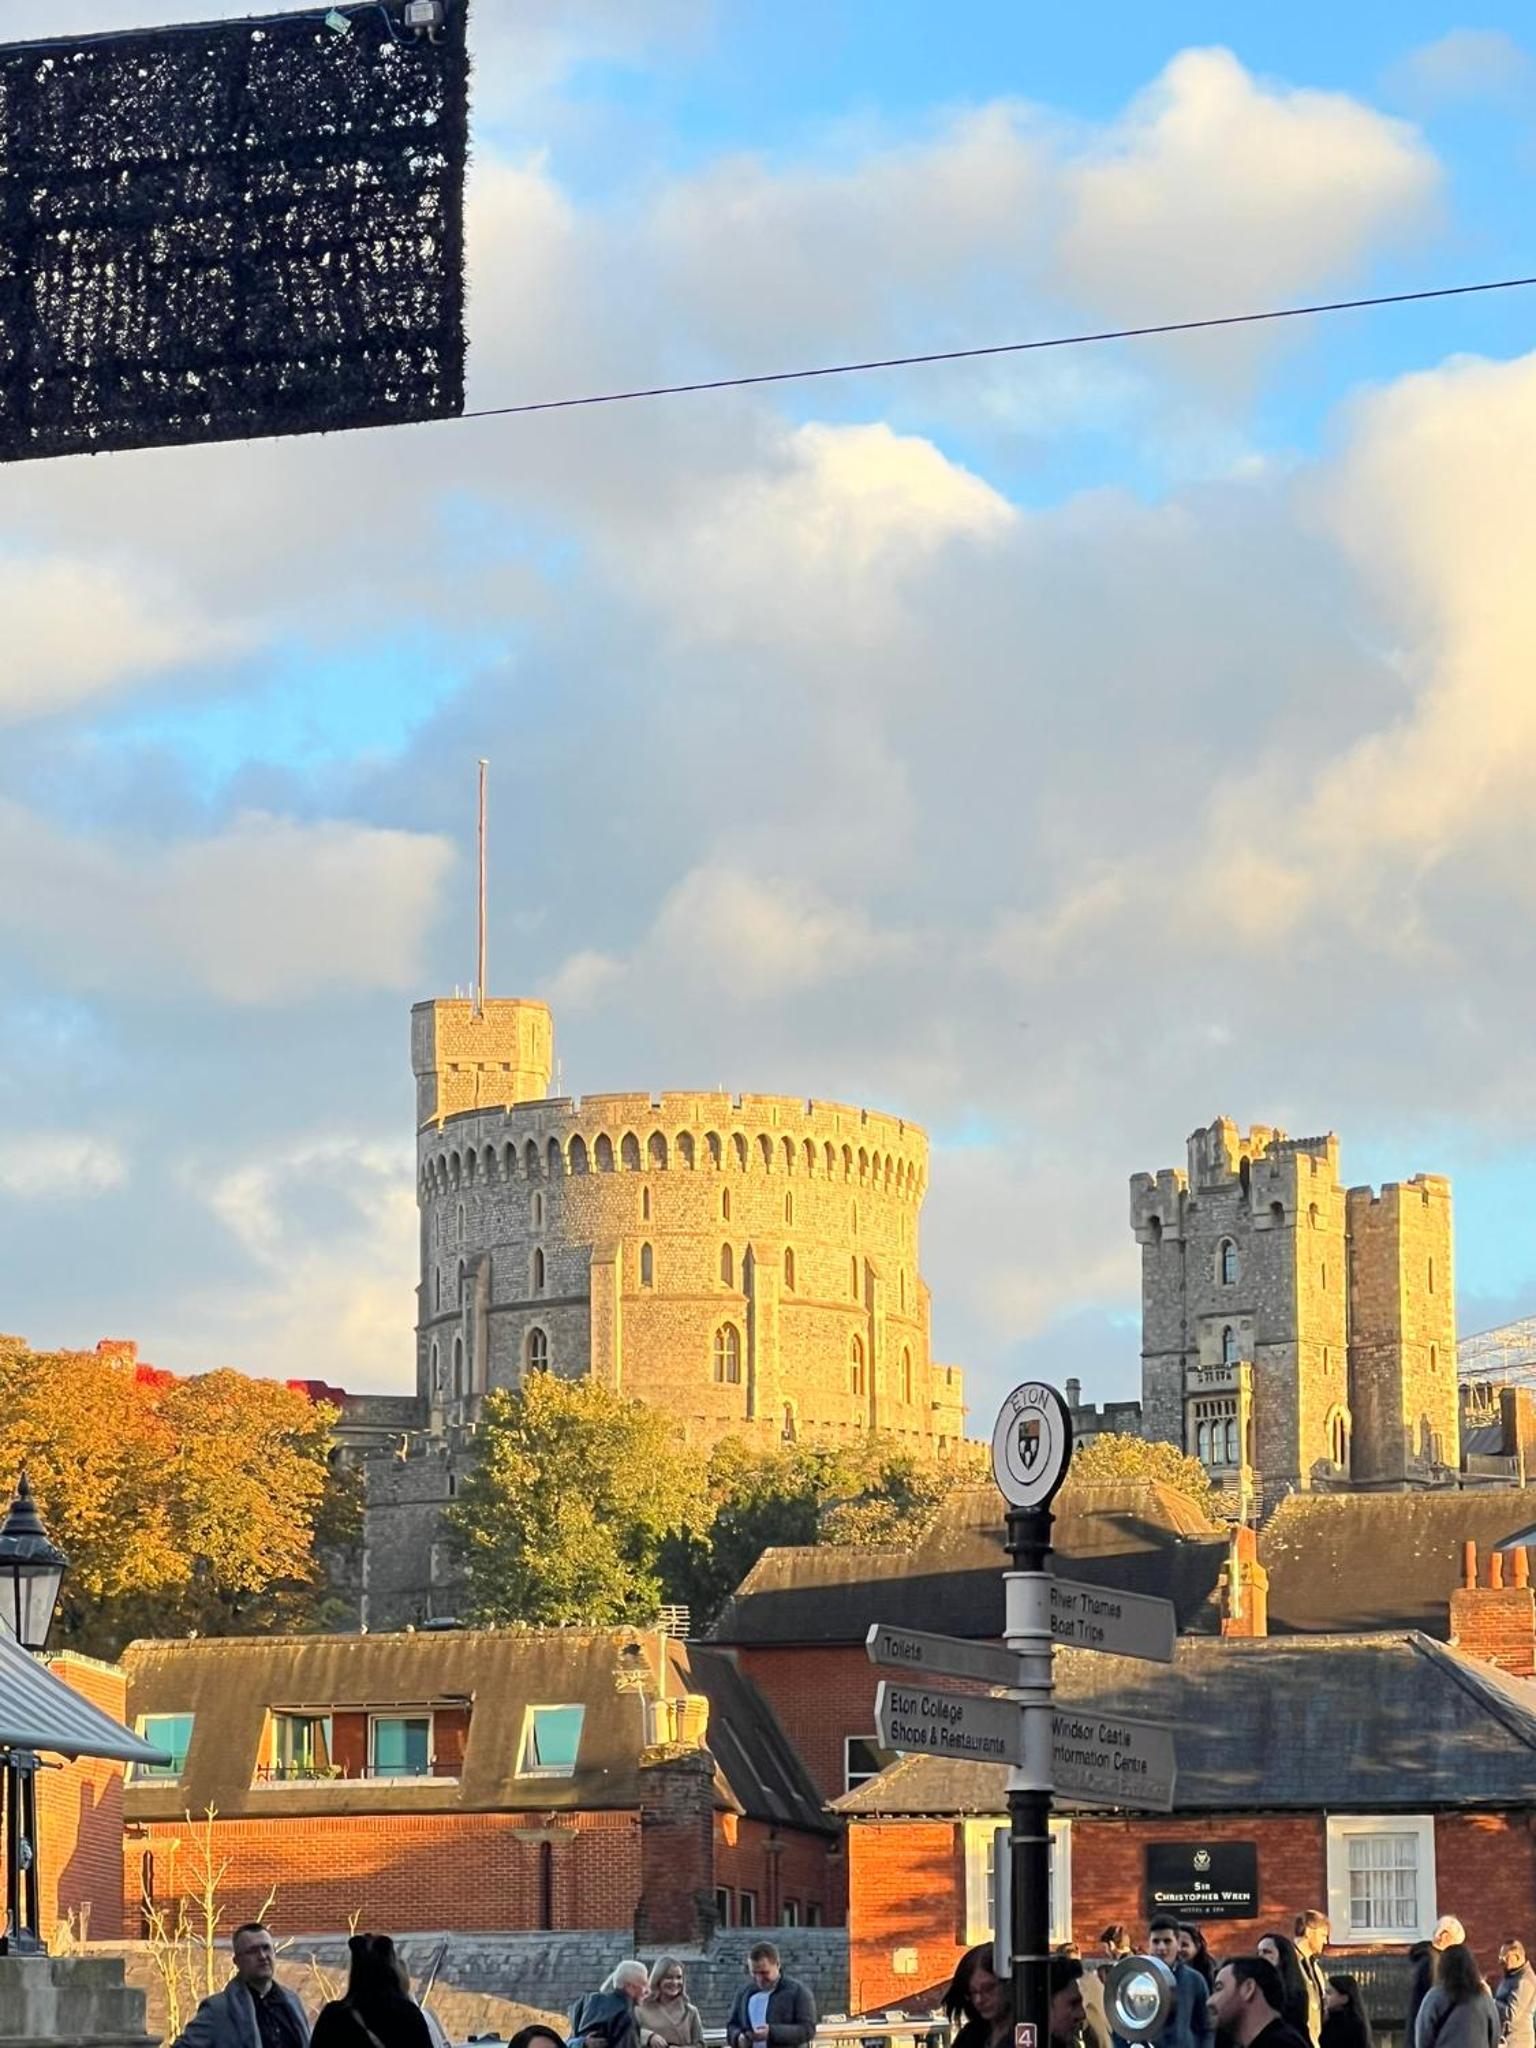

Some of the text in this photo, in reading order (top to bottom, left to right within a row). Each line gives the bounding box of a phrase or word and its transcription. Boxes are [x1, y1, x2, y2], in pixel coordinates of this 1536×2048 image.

[1011, 1387, 1049, 1413] ETON
[1050, 1587, 1122, 1618] River Thames
[1050, 1614, 1104, 1641] Boat Trips
[884, 1636, 923, 1661] Toilets
[890, 1692, 964, 1725] Eton College
[890, 1720, 1006, 1753] Shops & Restaurants
[1051, 1716, 1131, 1746] Windsor Castle
[1051, 1744, 1147, 1774] nformation Centre
[1154, 1890, 1251, 1902] CHRISTOPHER WREN
[1018, 2029, 1033, 2048] 4
